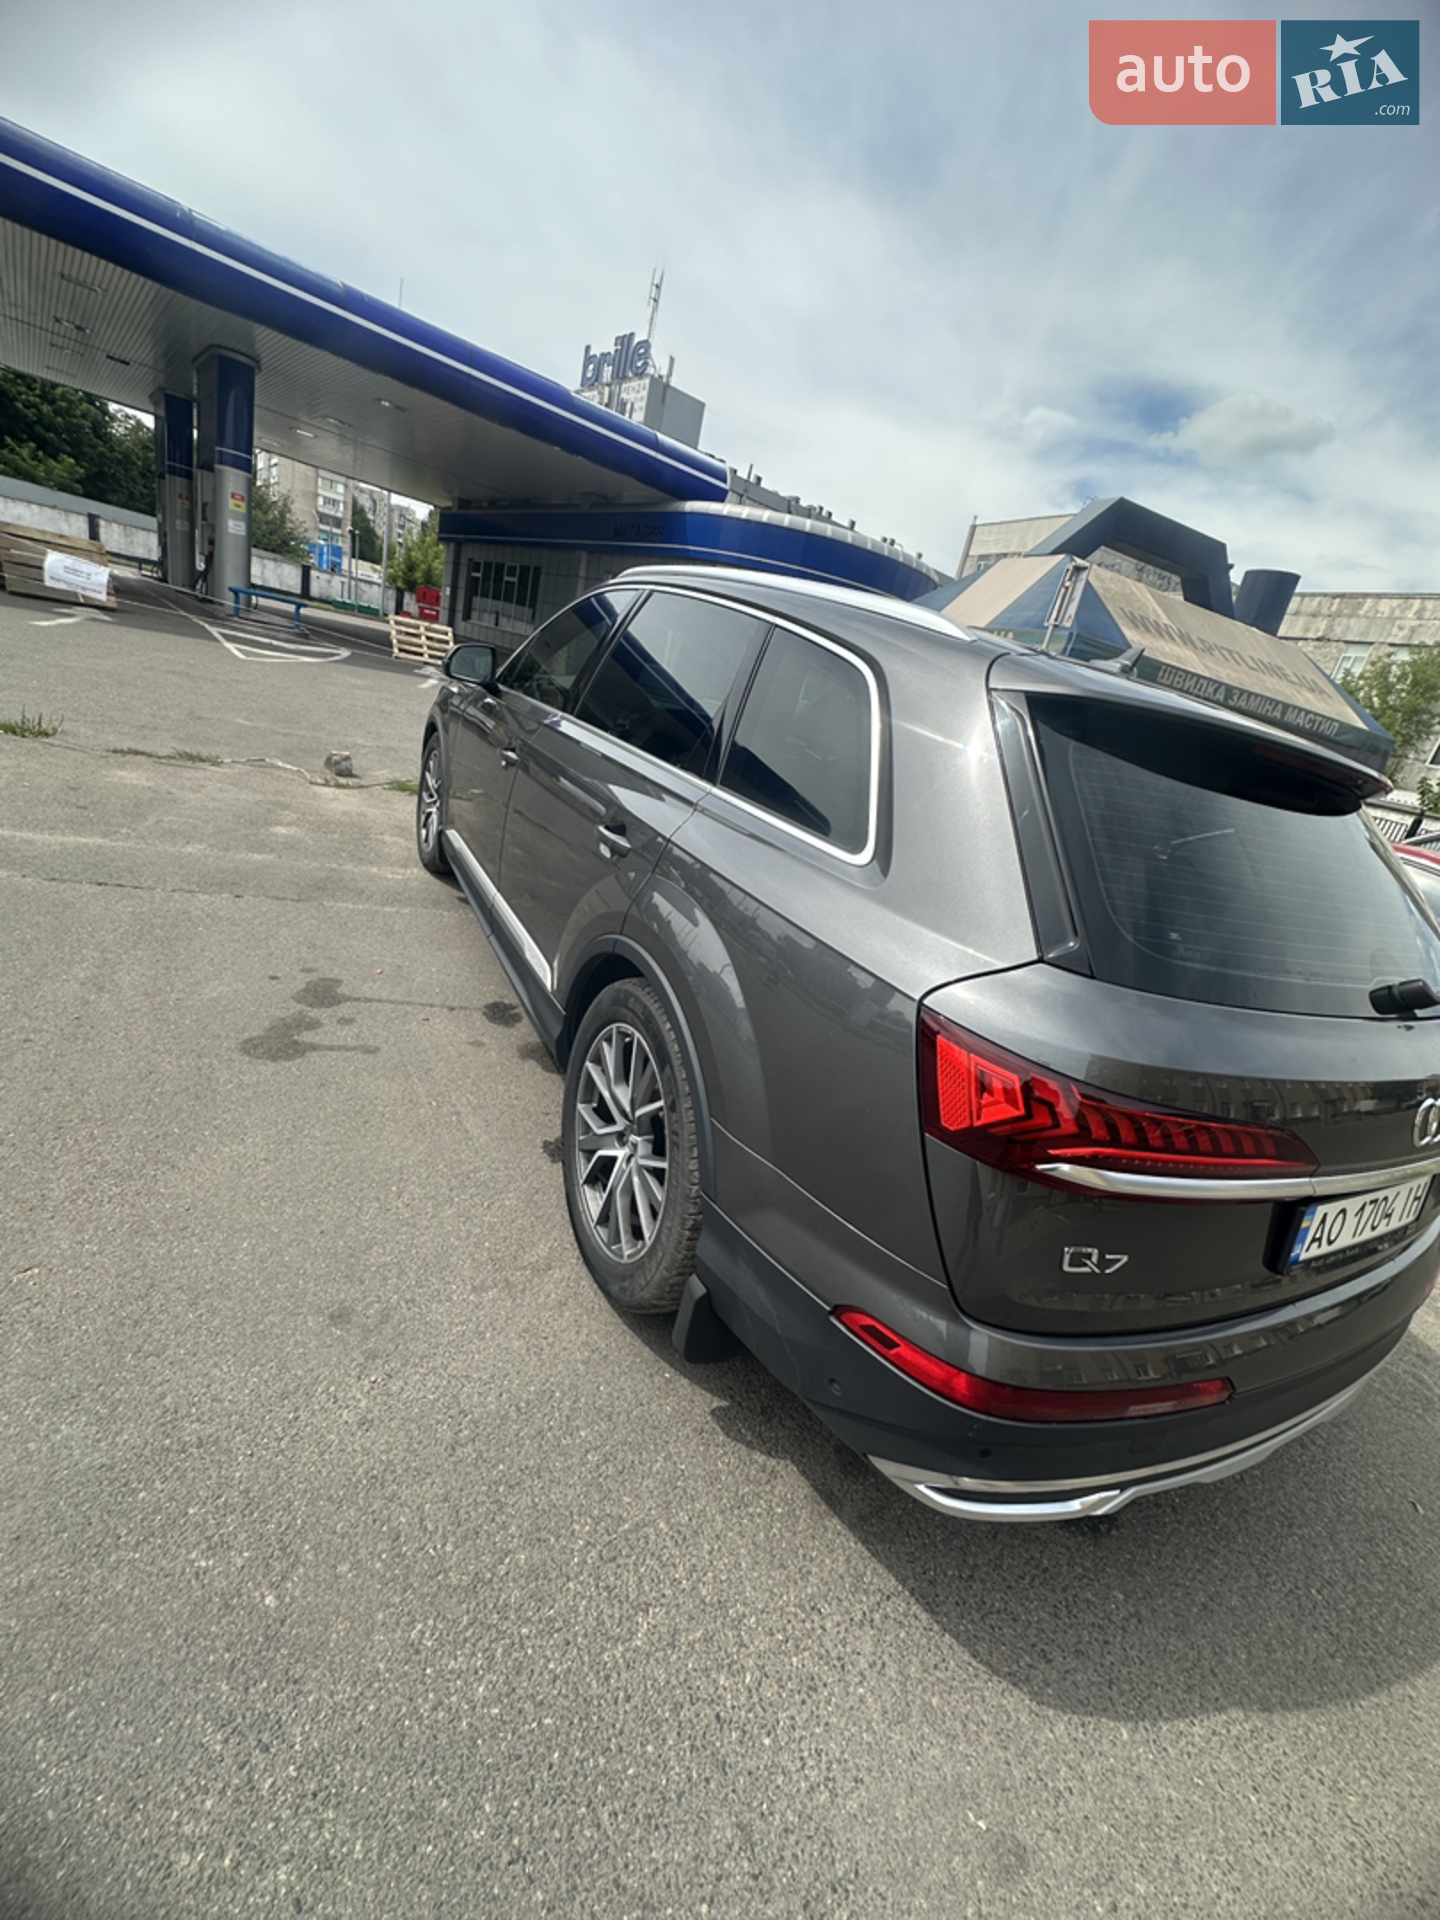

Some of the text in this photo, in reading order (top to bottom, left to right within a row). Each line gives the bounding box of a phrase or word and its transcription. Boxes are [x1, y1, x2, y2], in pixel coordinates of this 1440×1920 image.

[580, 331, 652, 389] brille
[1117, 606, 1333, 699] WWW.PITLINE.UA
[1157, 665, 1340, 738] ШВИДКА ЗАМІНА МАСТИЛ
[1305, 1206, 1347, 1253] AO
[1352, 1190, 1401, 1239] 1704
[1398, 1181, 1428, 1222] IH
[1062, 1246, 1129, 1274] Q7
